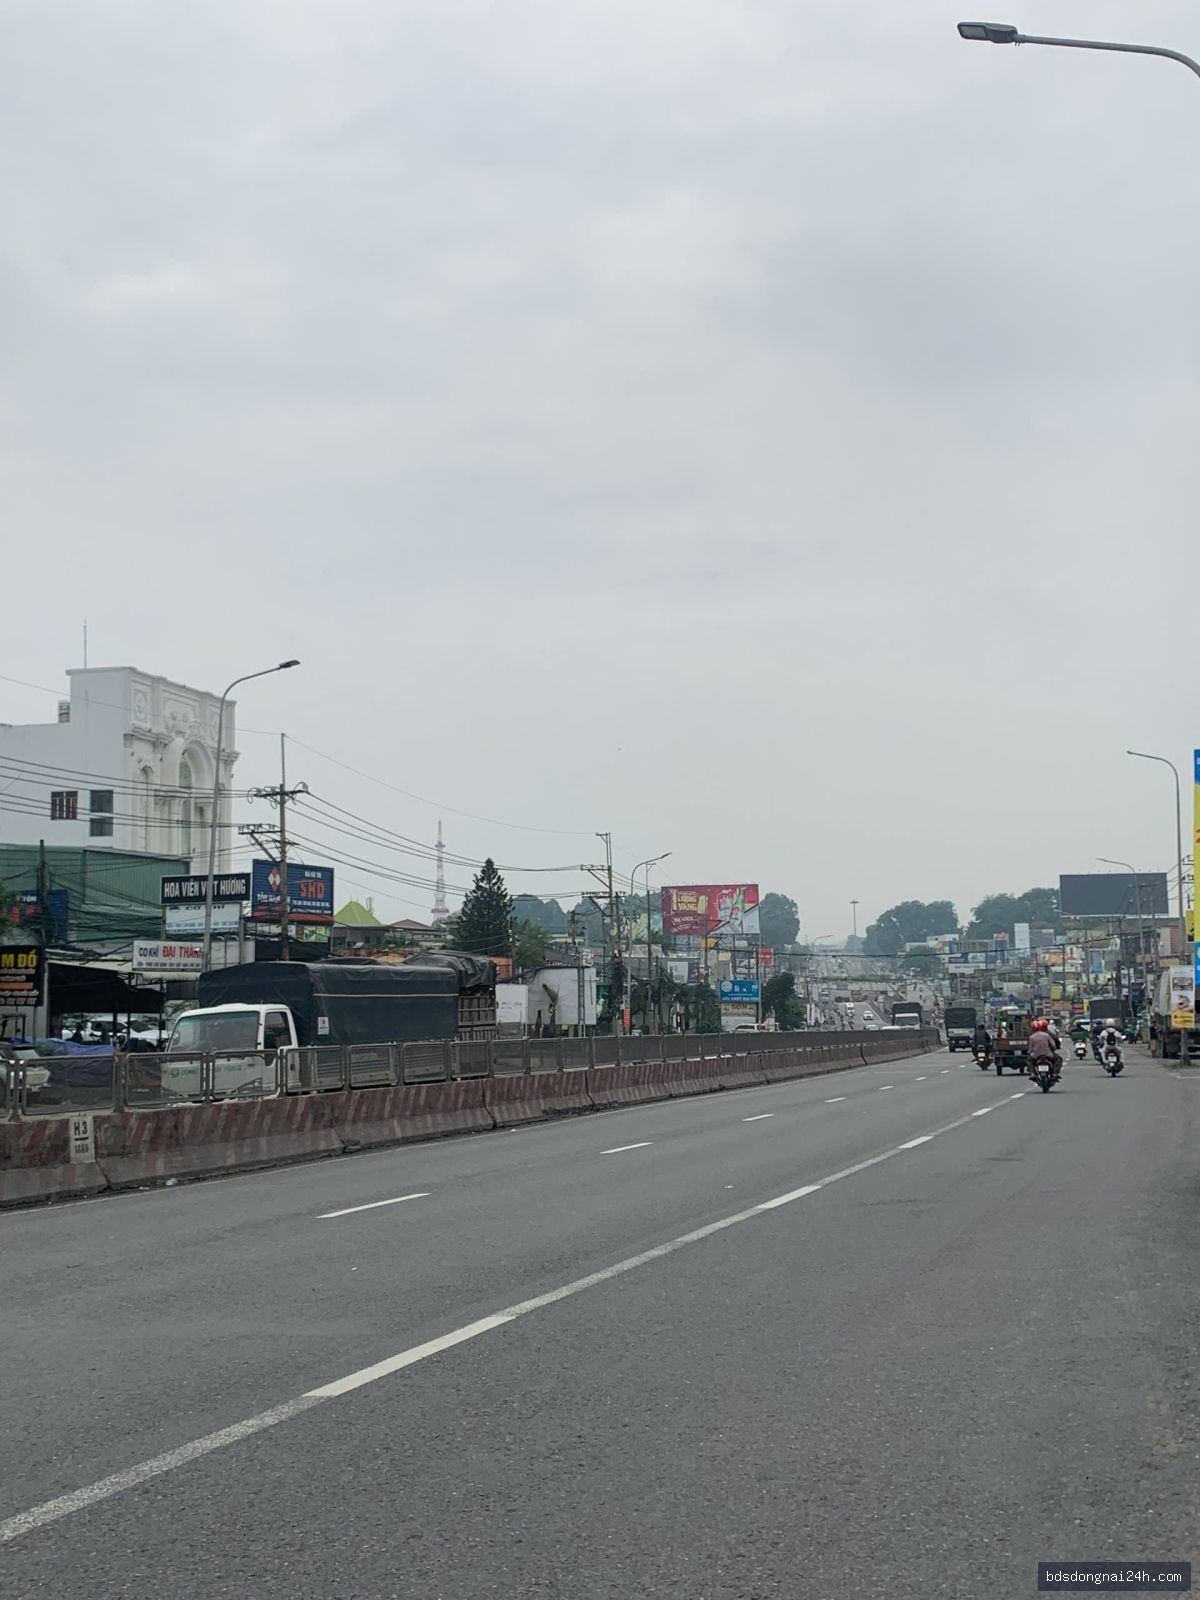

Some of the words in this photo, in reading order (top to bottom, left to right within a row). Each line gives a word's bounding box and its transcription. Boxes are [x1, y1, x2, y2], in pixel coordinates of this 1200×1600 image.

[164, 882, 180, 898] HOA
[181, 879, 200, 897] VIÊN
[201, 880, 219, 896] VT
[299, 880, 325, 898] SHD
[162, 945, 176, 960] ĐẠI
